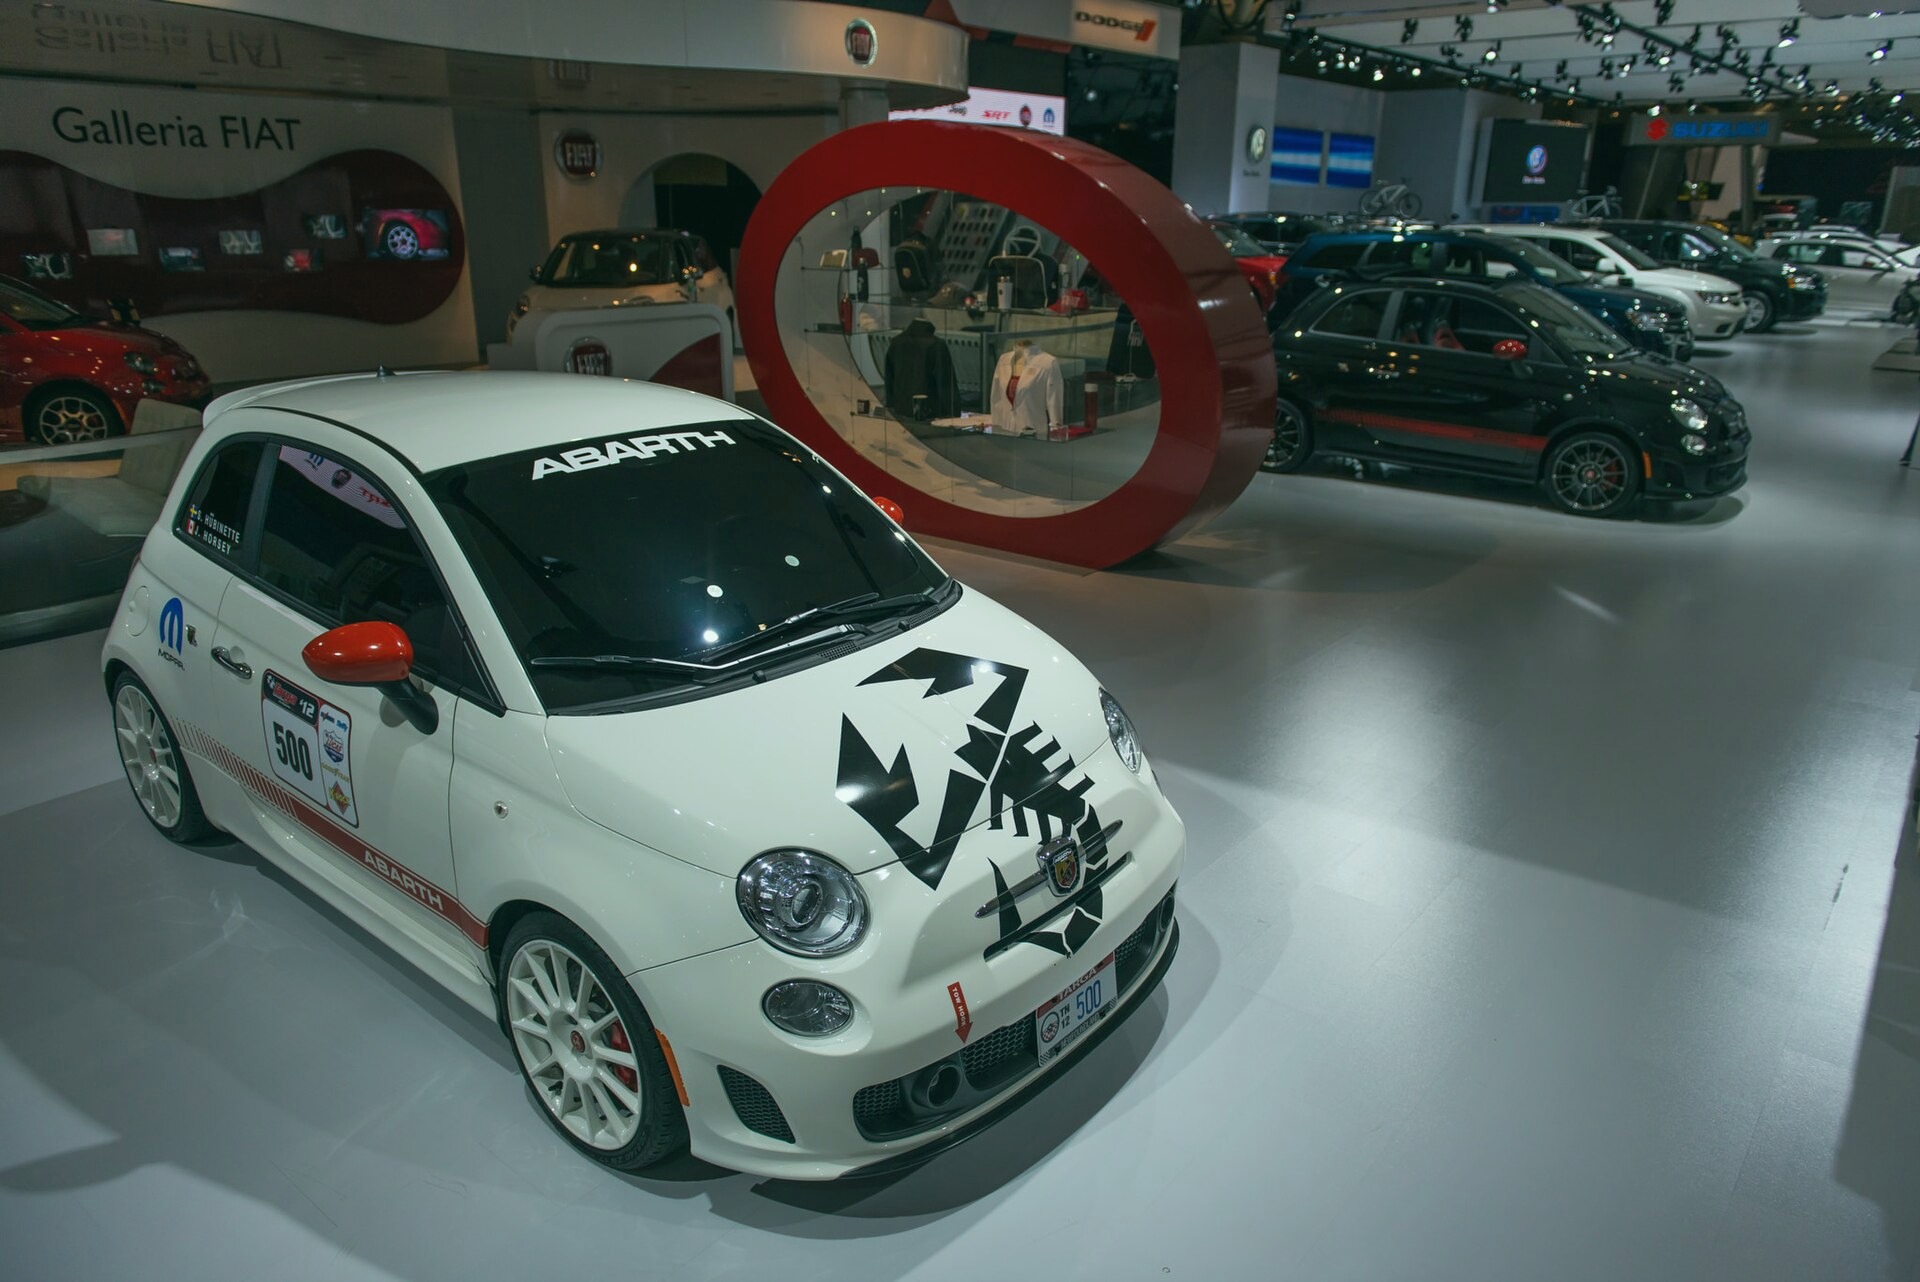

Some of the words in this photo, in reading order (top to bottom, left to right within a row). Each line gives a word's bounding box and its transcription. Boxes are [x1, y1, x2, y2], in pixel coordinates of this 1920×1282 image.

[1075, 11, 1144, 32] DODGE
[52, 106, 208, 148] Galleria
[219, 115, 300, 151] FIAT
[982, 109, 1011, 120] SRT
[1672, 120, 1769, 139] SUZUKI
[532, 430, 737, 481] ABARTH
[194, 525, 200, 537] J.
[202, 530, 231, 555] HORSEY
[197, 509, 203, 522] S.
[204, 511, 240, 544] HÜBINETTE
[273, 721, 313, 781] 500
[325, 738, 343, 752] LUCAS
[364, 850, 444, 911] ABARTH
[1061, 967, 1097, 999] TARGA
[952, 986, 961, 1004] TOW
[958, 1005, 967, 1027] HOOK
[1060, 1004, 1070, 1017] TN
[1076, 979, 1102, 1020] 500
[1061, 1016, 1071, 1029] 12
